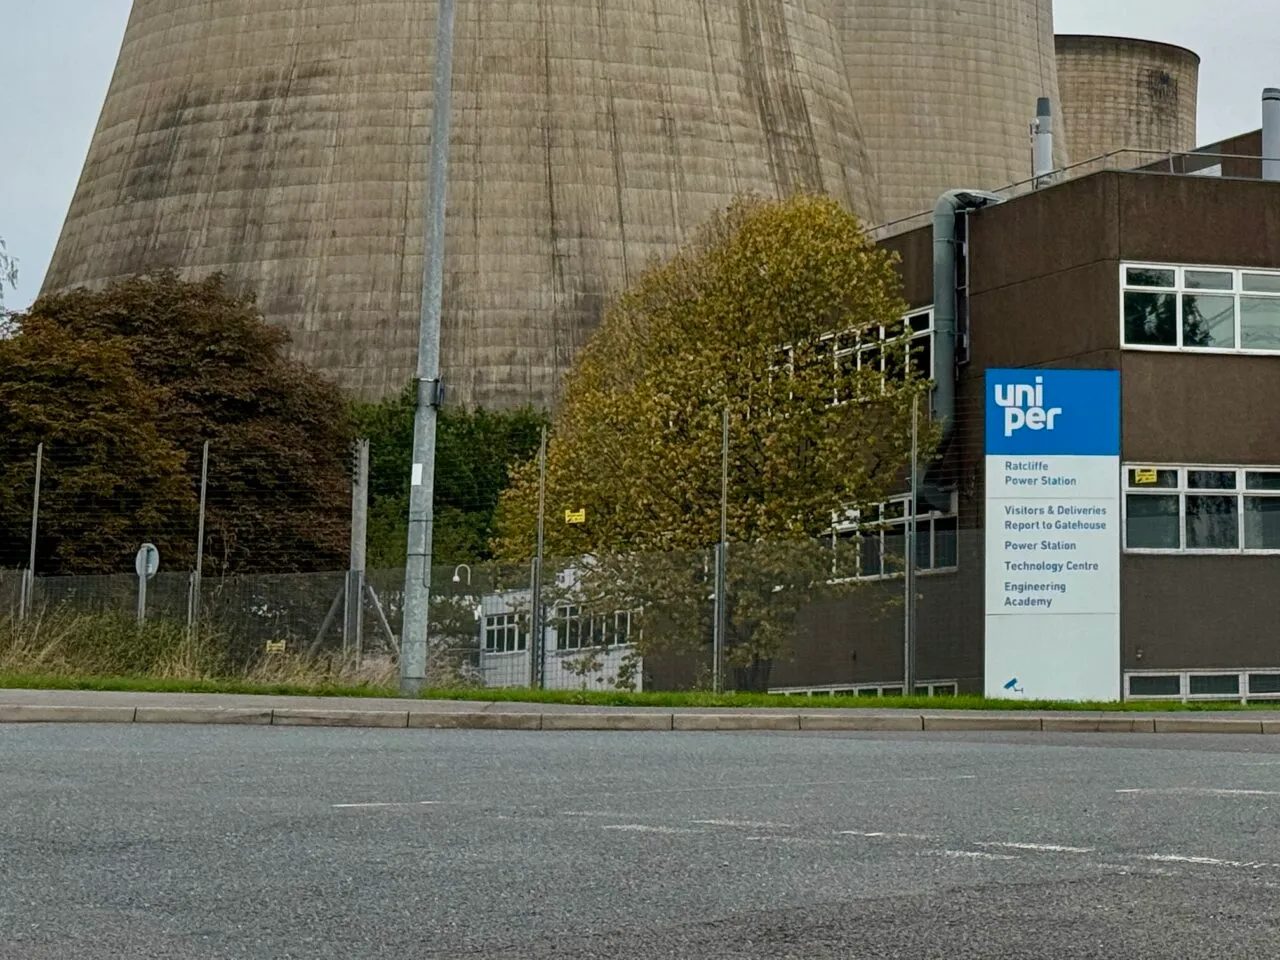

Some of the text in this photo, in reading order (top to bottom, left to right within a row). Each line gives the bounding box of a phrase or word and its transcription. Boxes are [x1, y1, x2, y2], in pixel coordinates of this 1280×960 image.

[995, 376, 1043, 407] uni
[1005, 407, 1062, 437] per
[1005, 461, 1049, 471] Ratcliffe
[1005, 476, 1077, 486] Power Station
[1004, 505, 1107, 515] Visitors & Deliveries
[1004, 520, 1107, 531] Report to Gatehouse
[1004, 540, 1077, 550] Power Station
[1004, 561, 1099, 572] Technology Centre
[1004, 581, 1067, 593] Engineering
[1004, 597, 1052, 608] Academy
